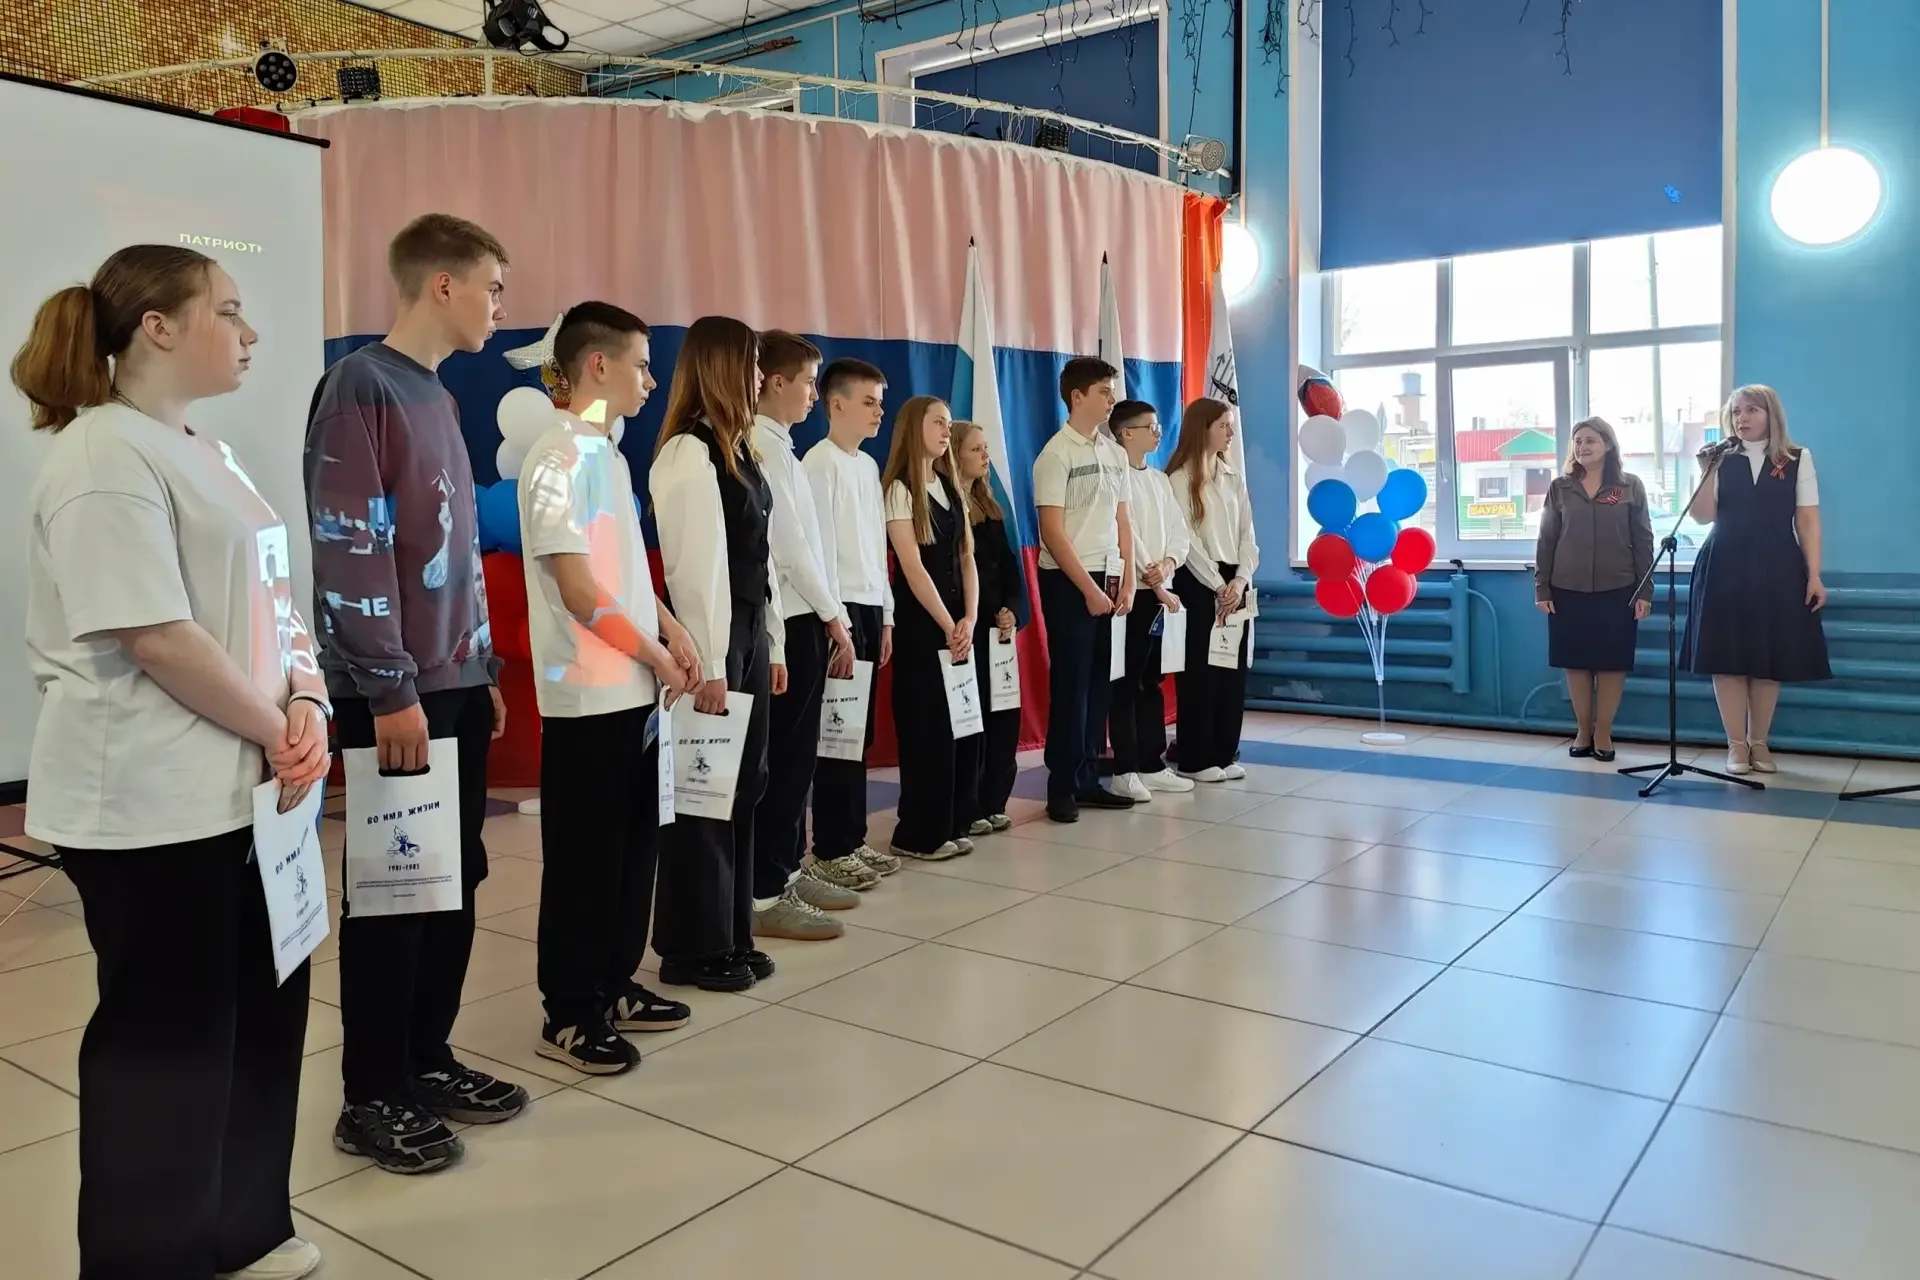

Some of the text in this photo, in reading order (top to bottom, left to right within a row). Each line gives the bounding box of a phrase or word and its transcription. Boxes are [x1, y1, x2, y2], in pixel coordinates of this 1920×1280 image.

[367, 801, 440, 825] ВО ИМЯ ЖИЗНИ
